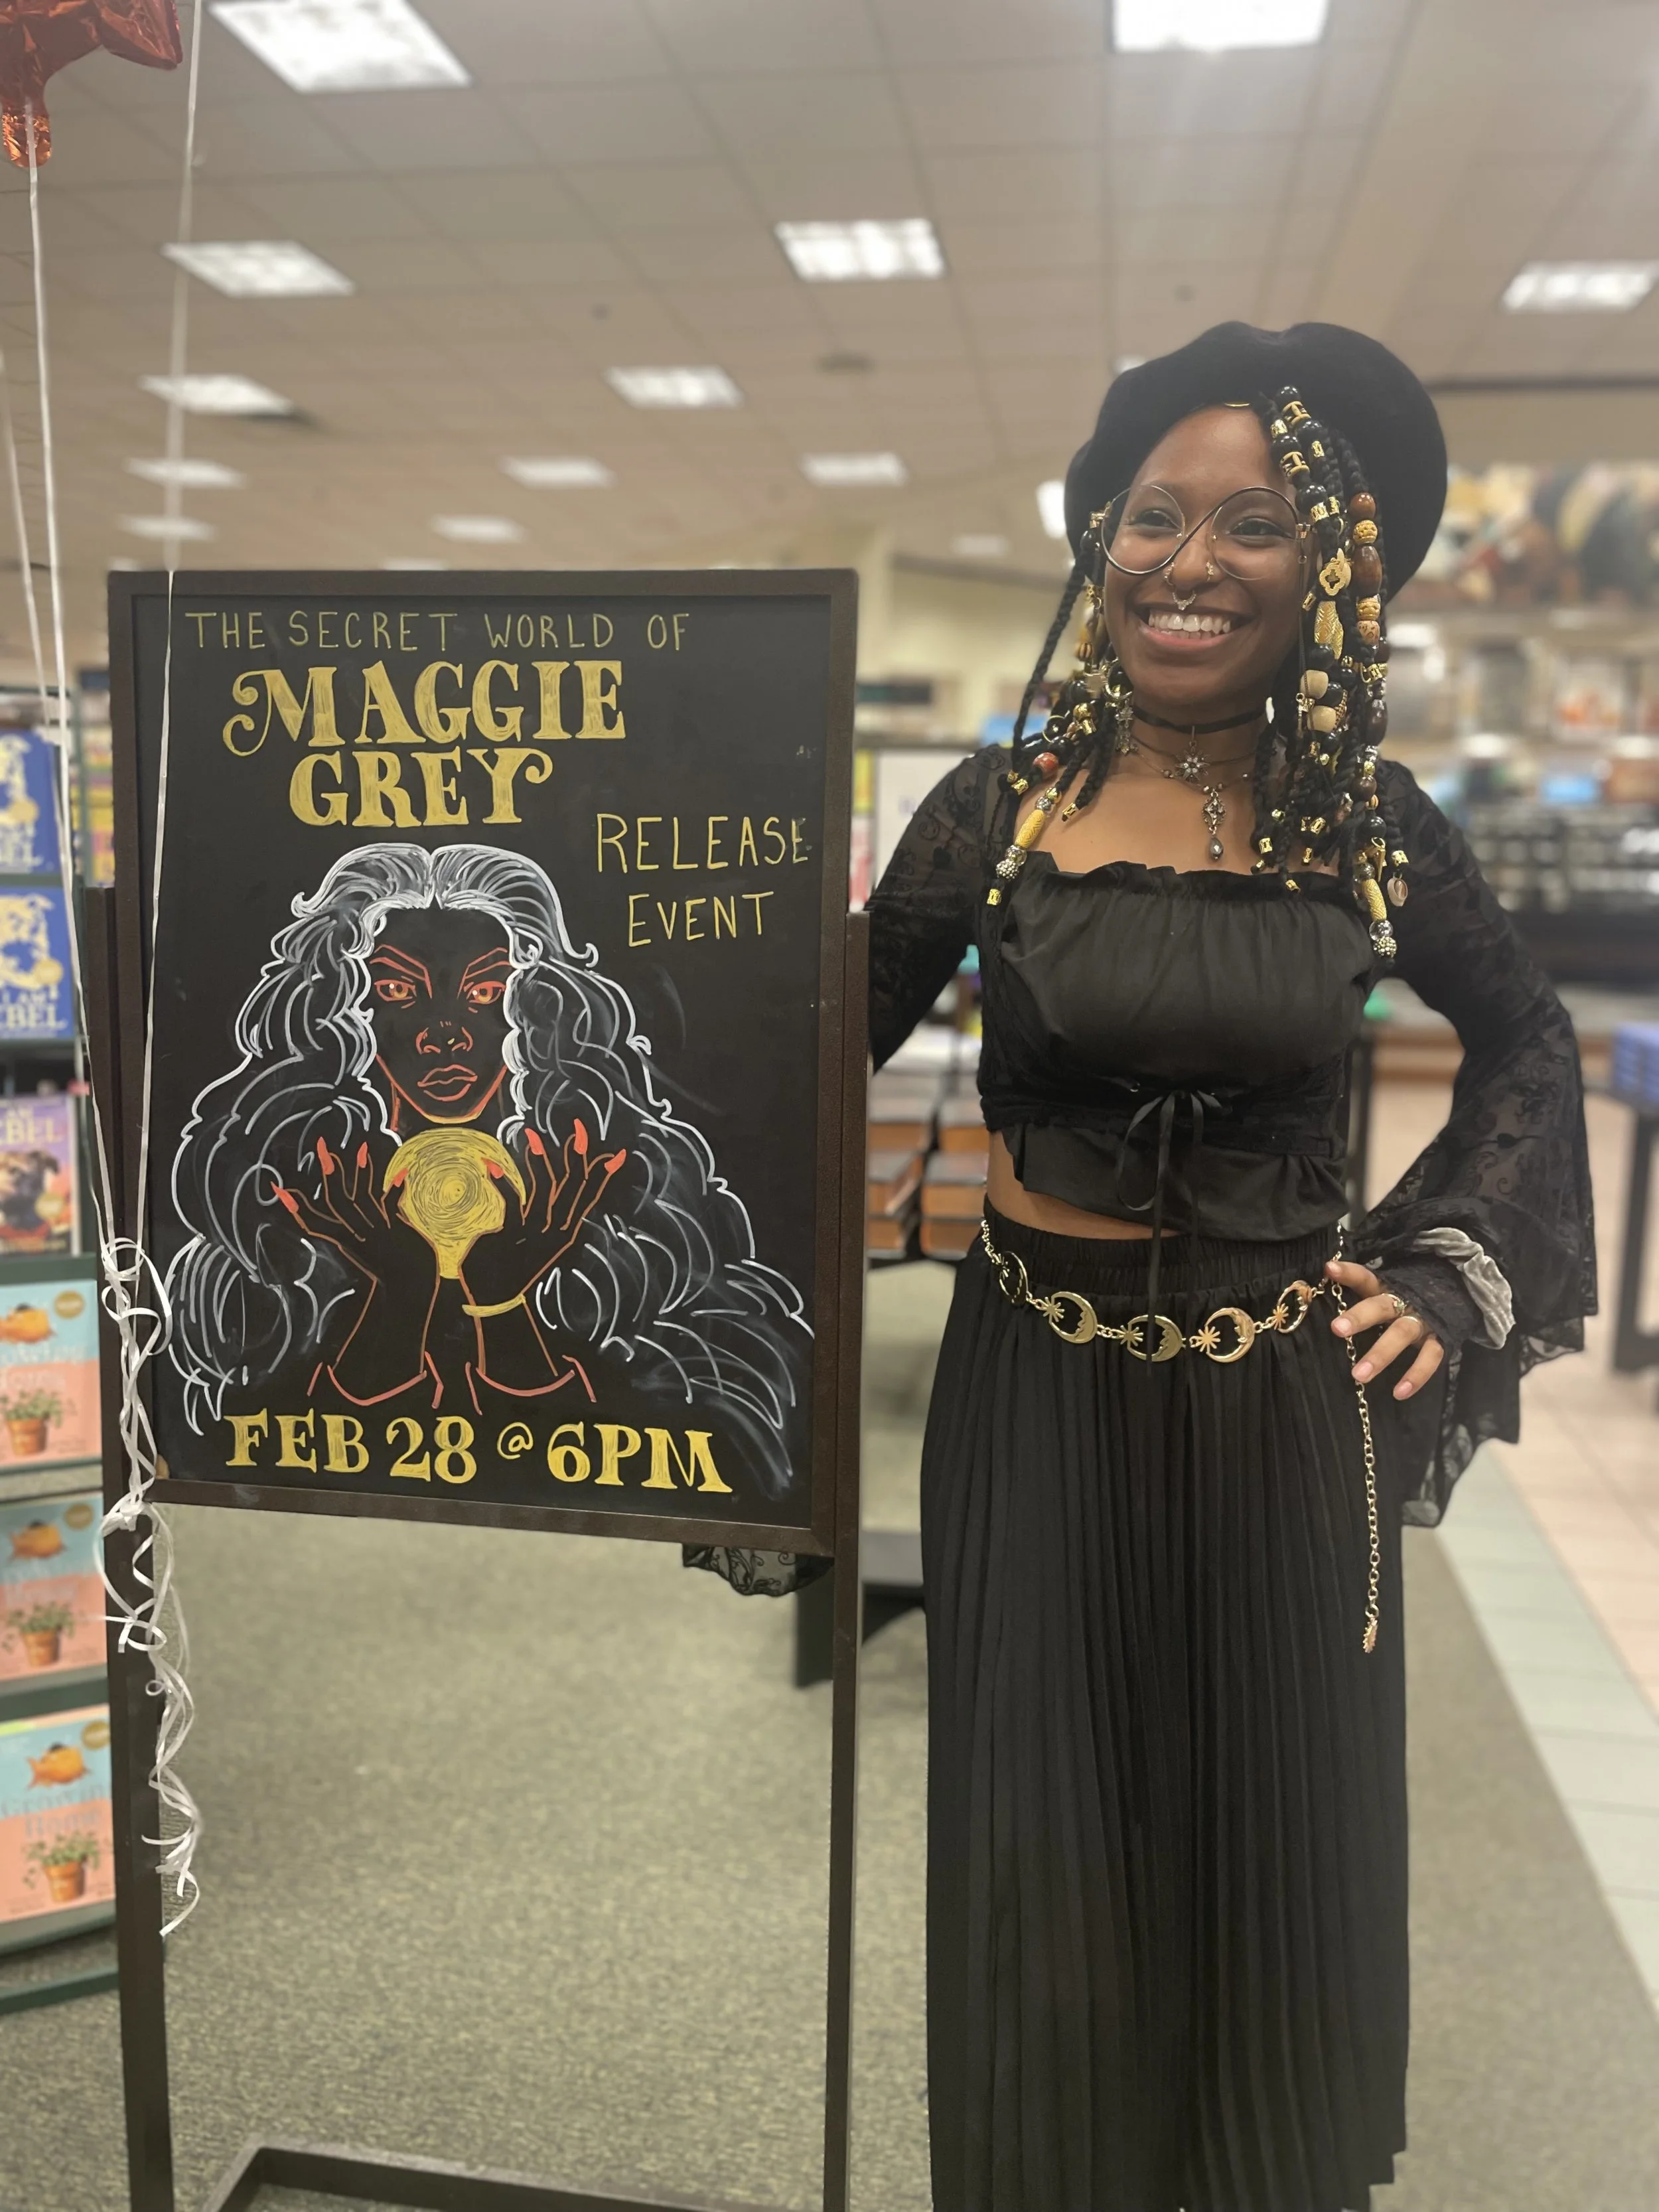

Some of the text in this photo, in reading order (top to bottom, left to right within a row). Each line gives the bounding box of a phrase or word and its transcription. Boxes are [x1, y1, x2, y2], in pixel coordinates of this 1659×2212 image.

[186, 610, 689, 651] THE SECRET WORLD OF
[222, 660, 626, 757] MAGGIE
[289, 746, 553, 828] GREY
[597, 812, 812, 873] RELEASE
[628, 891, 774, 947] EVENT
[223, 1408, 733, 1493] FEB 28 @ 6PM
